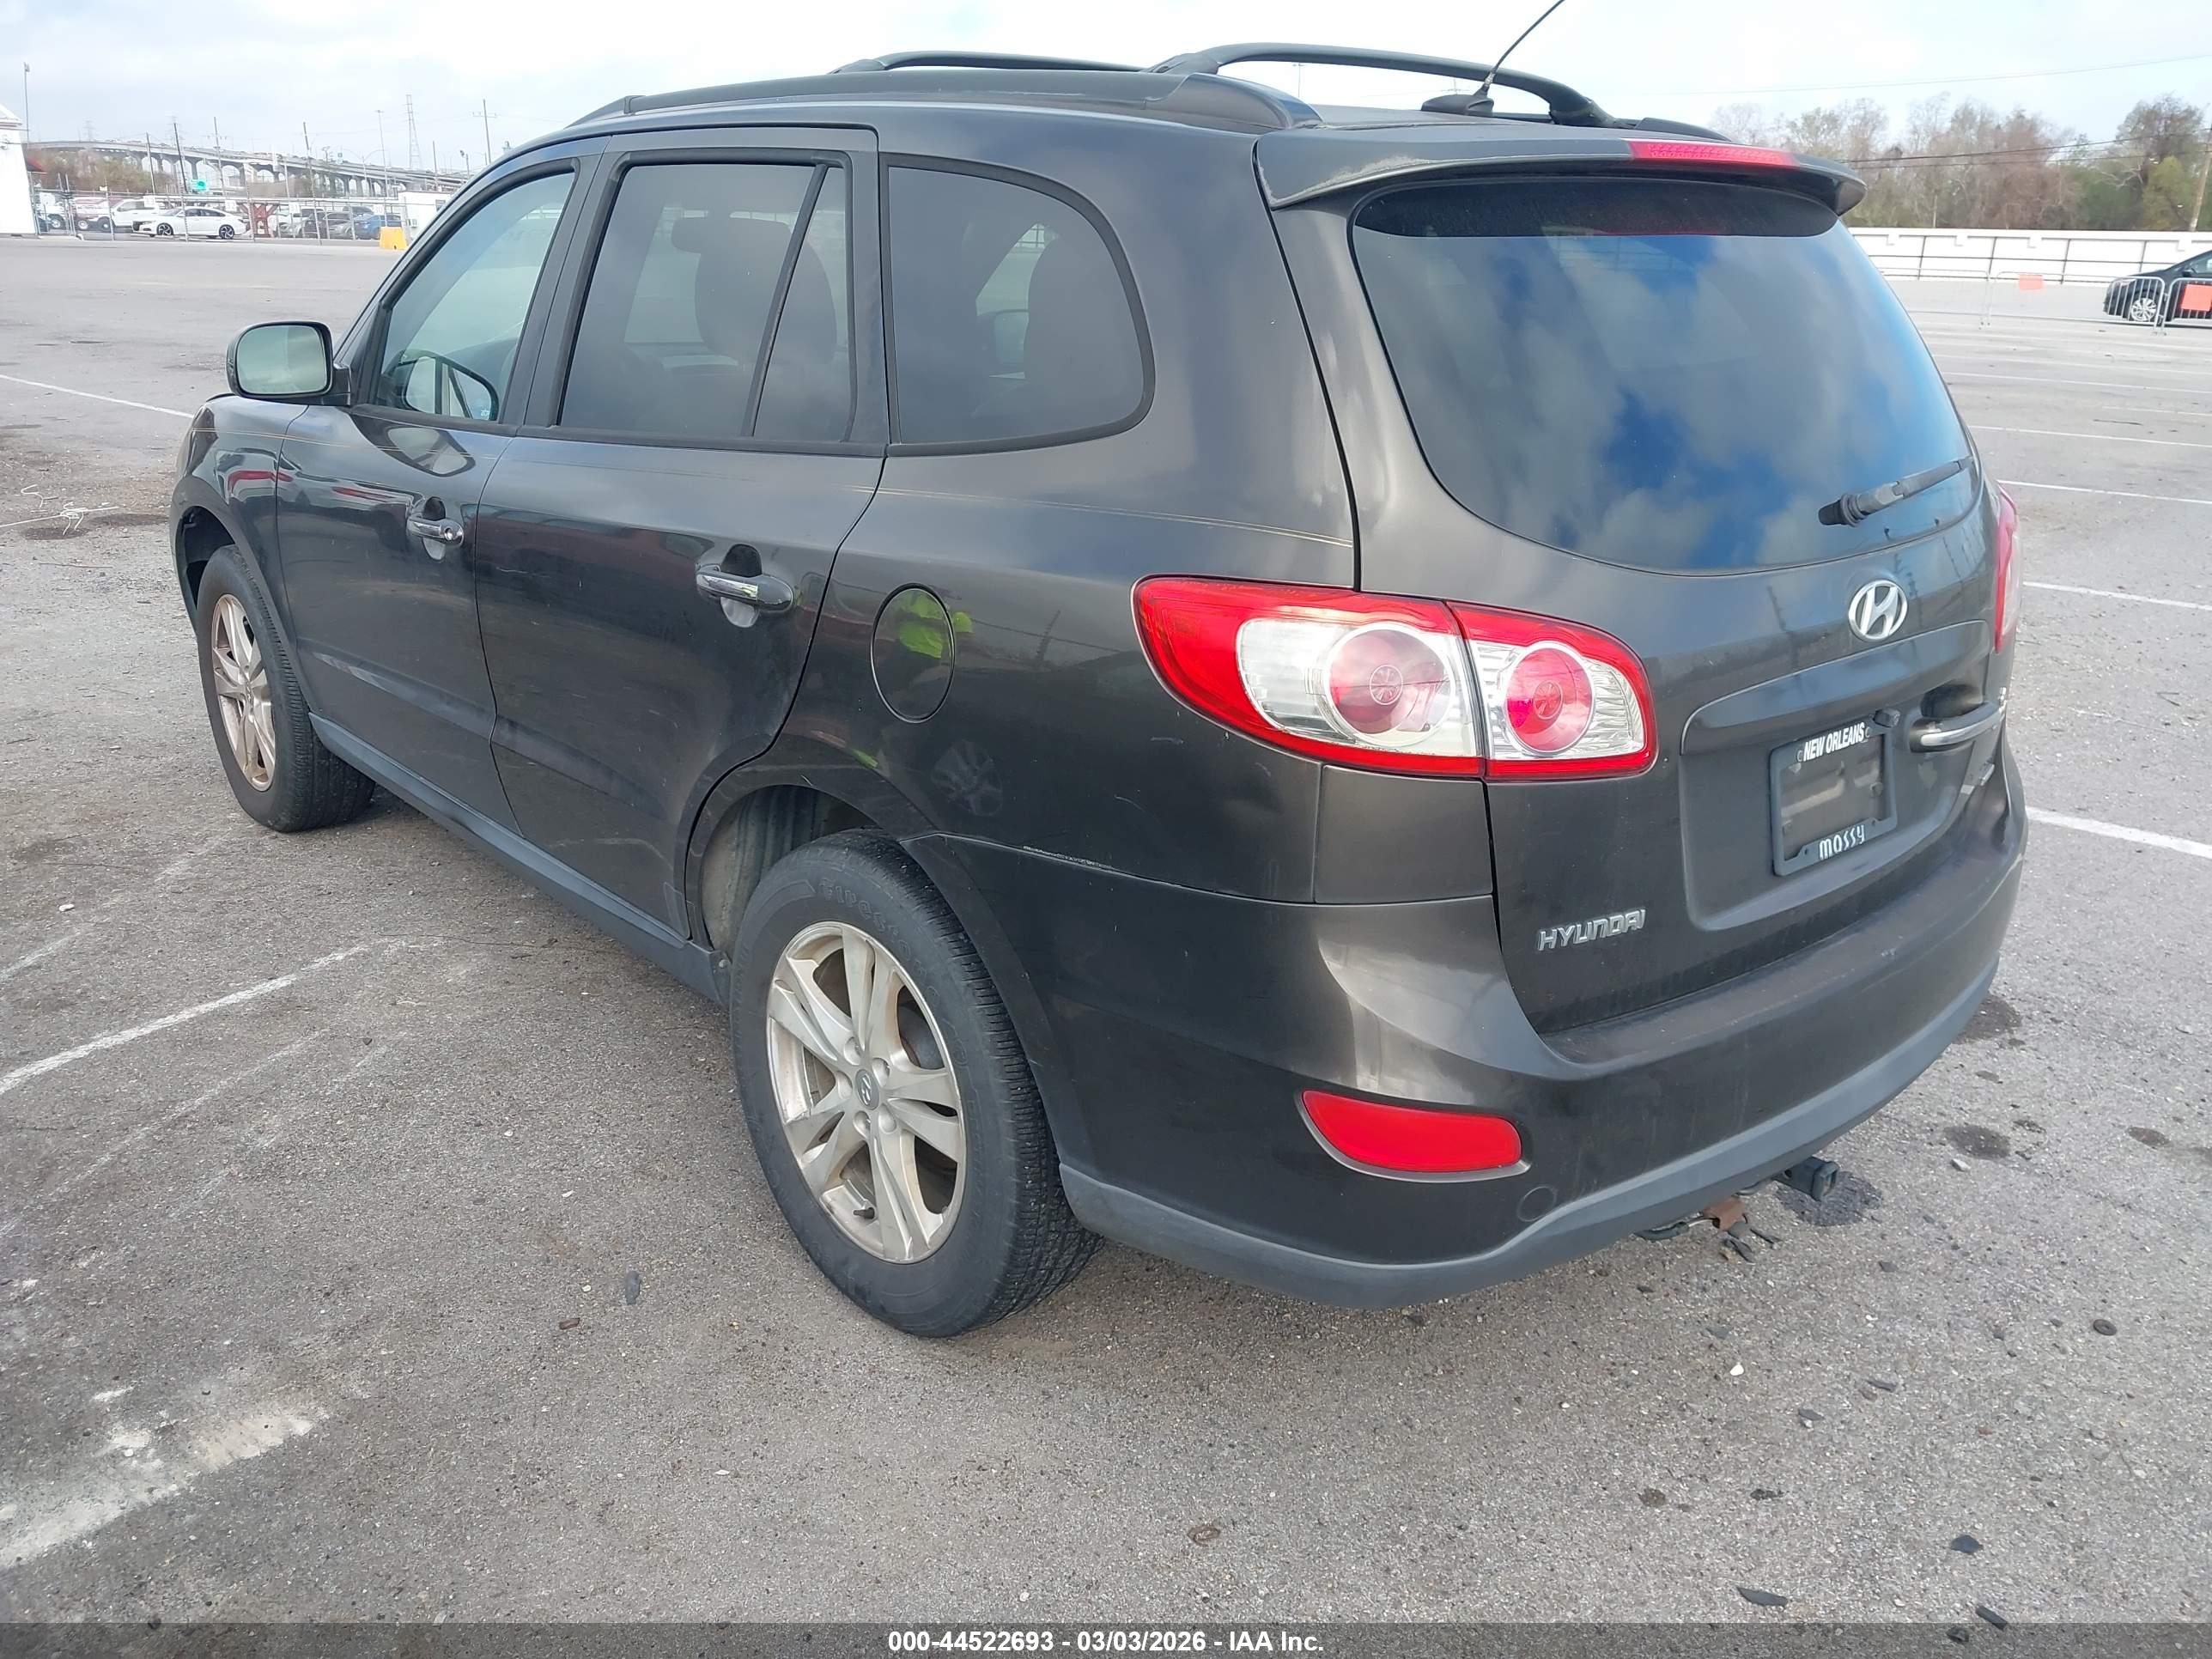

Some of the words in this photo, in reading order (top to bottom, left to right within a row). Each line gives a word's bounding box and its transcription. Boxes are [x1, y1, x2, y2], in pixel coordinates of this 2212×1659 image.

[1803, 738, 1826, 762] NEW
[1826, 722, 1865, 754] ORLEANS
[1537, 908, 1646, 951] HYUNDAI
